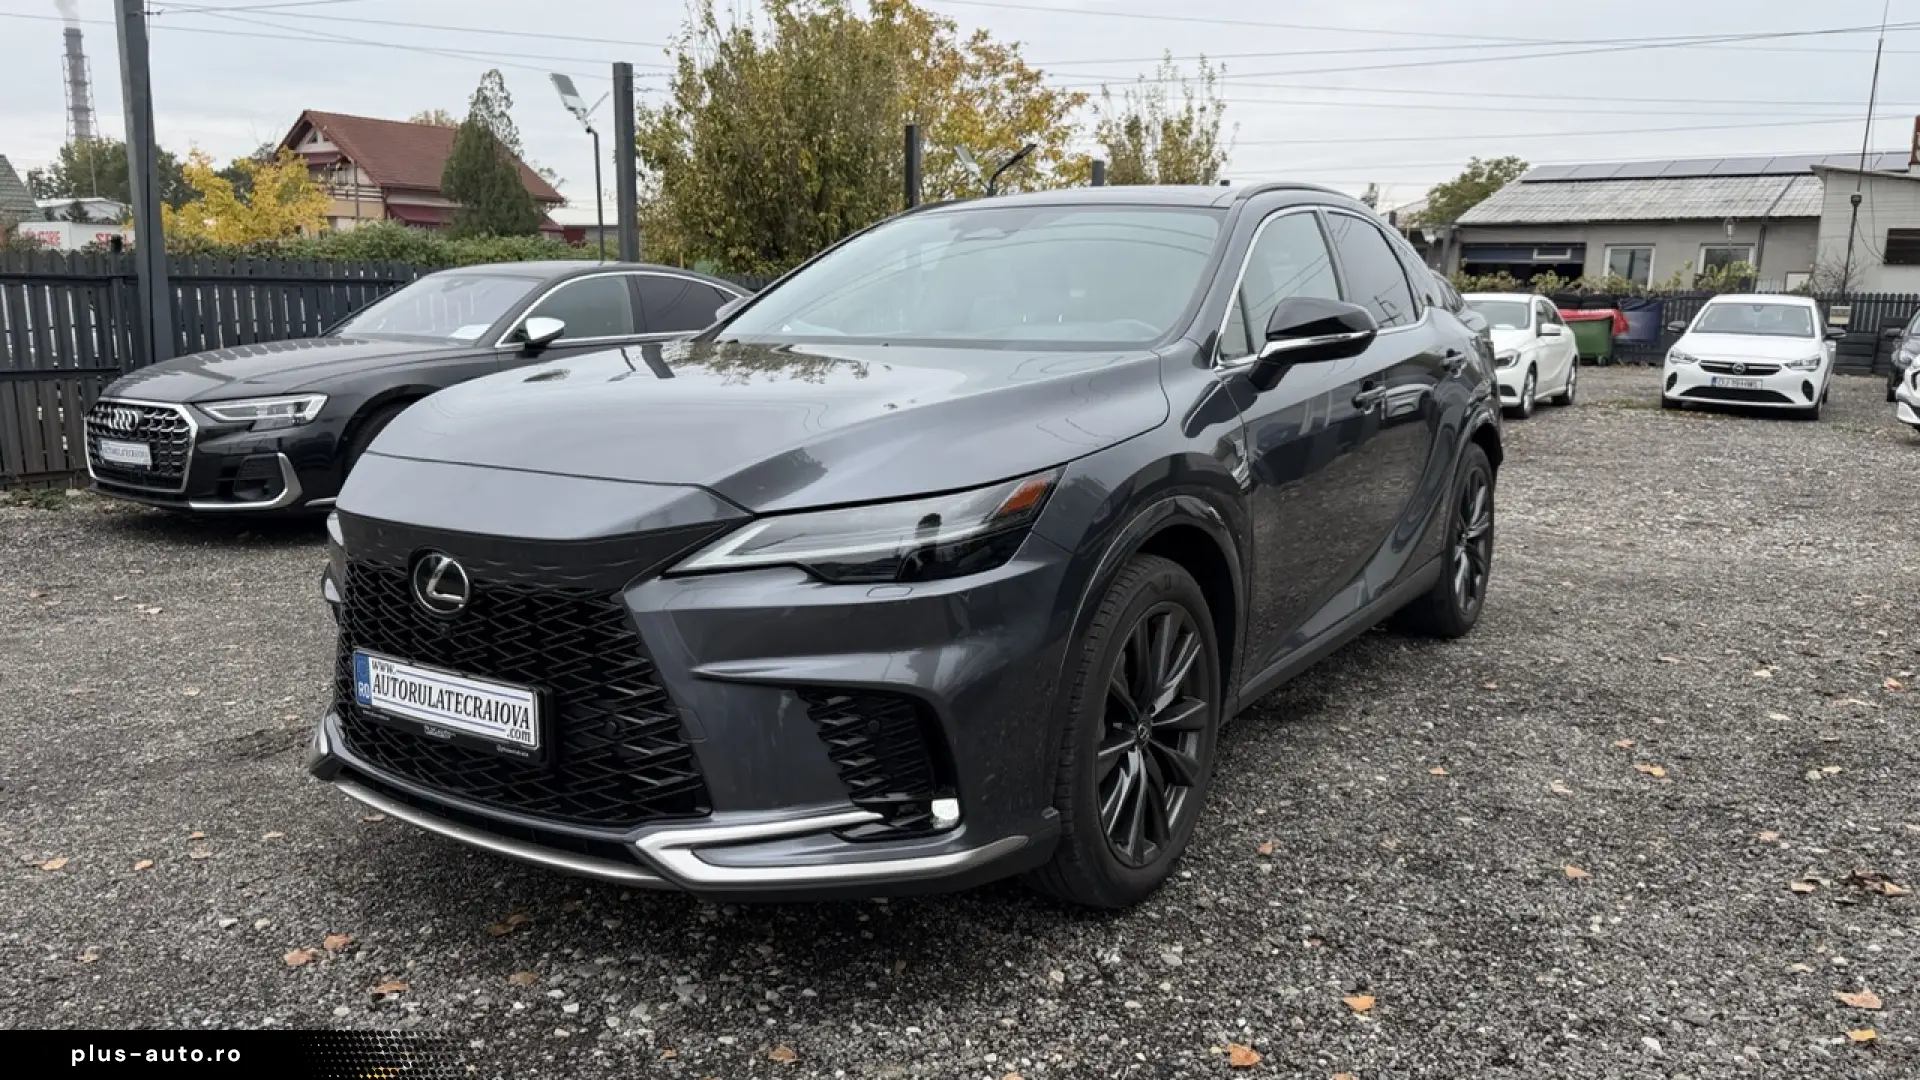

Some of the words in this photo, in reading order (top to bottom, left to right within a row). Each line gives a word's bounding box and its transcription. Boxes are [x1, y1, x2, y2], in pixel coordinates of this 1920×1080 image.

[372, 659, 397, 675] www.
[358, 682, 370, 699] RO
[372, 672, 531, 730] AUTORULATECRAIOVA
[506, 728, 531, 742] .com
